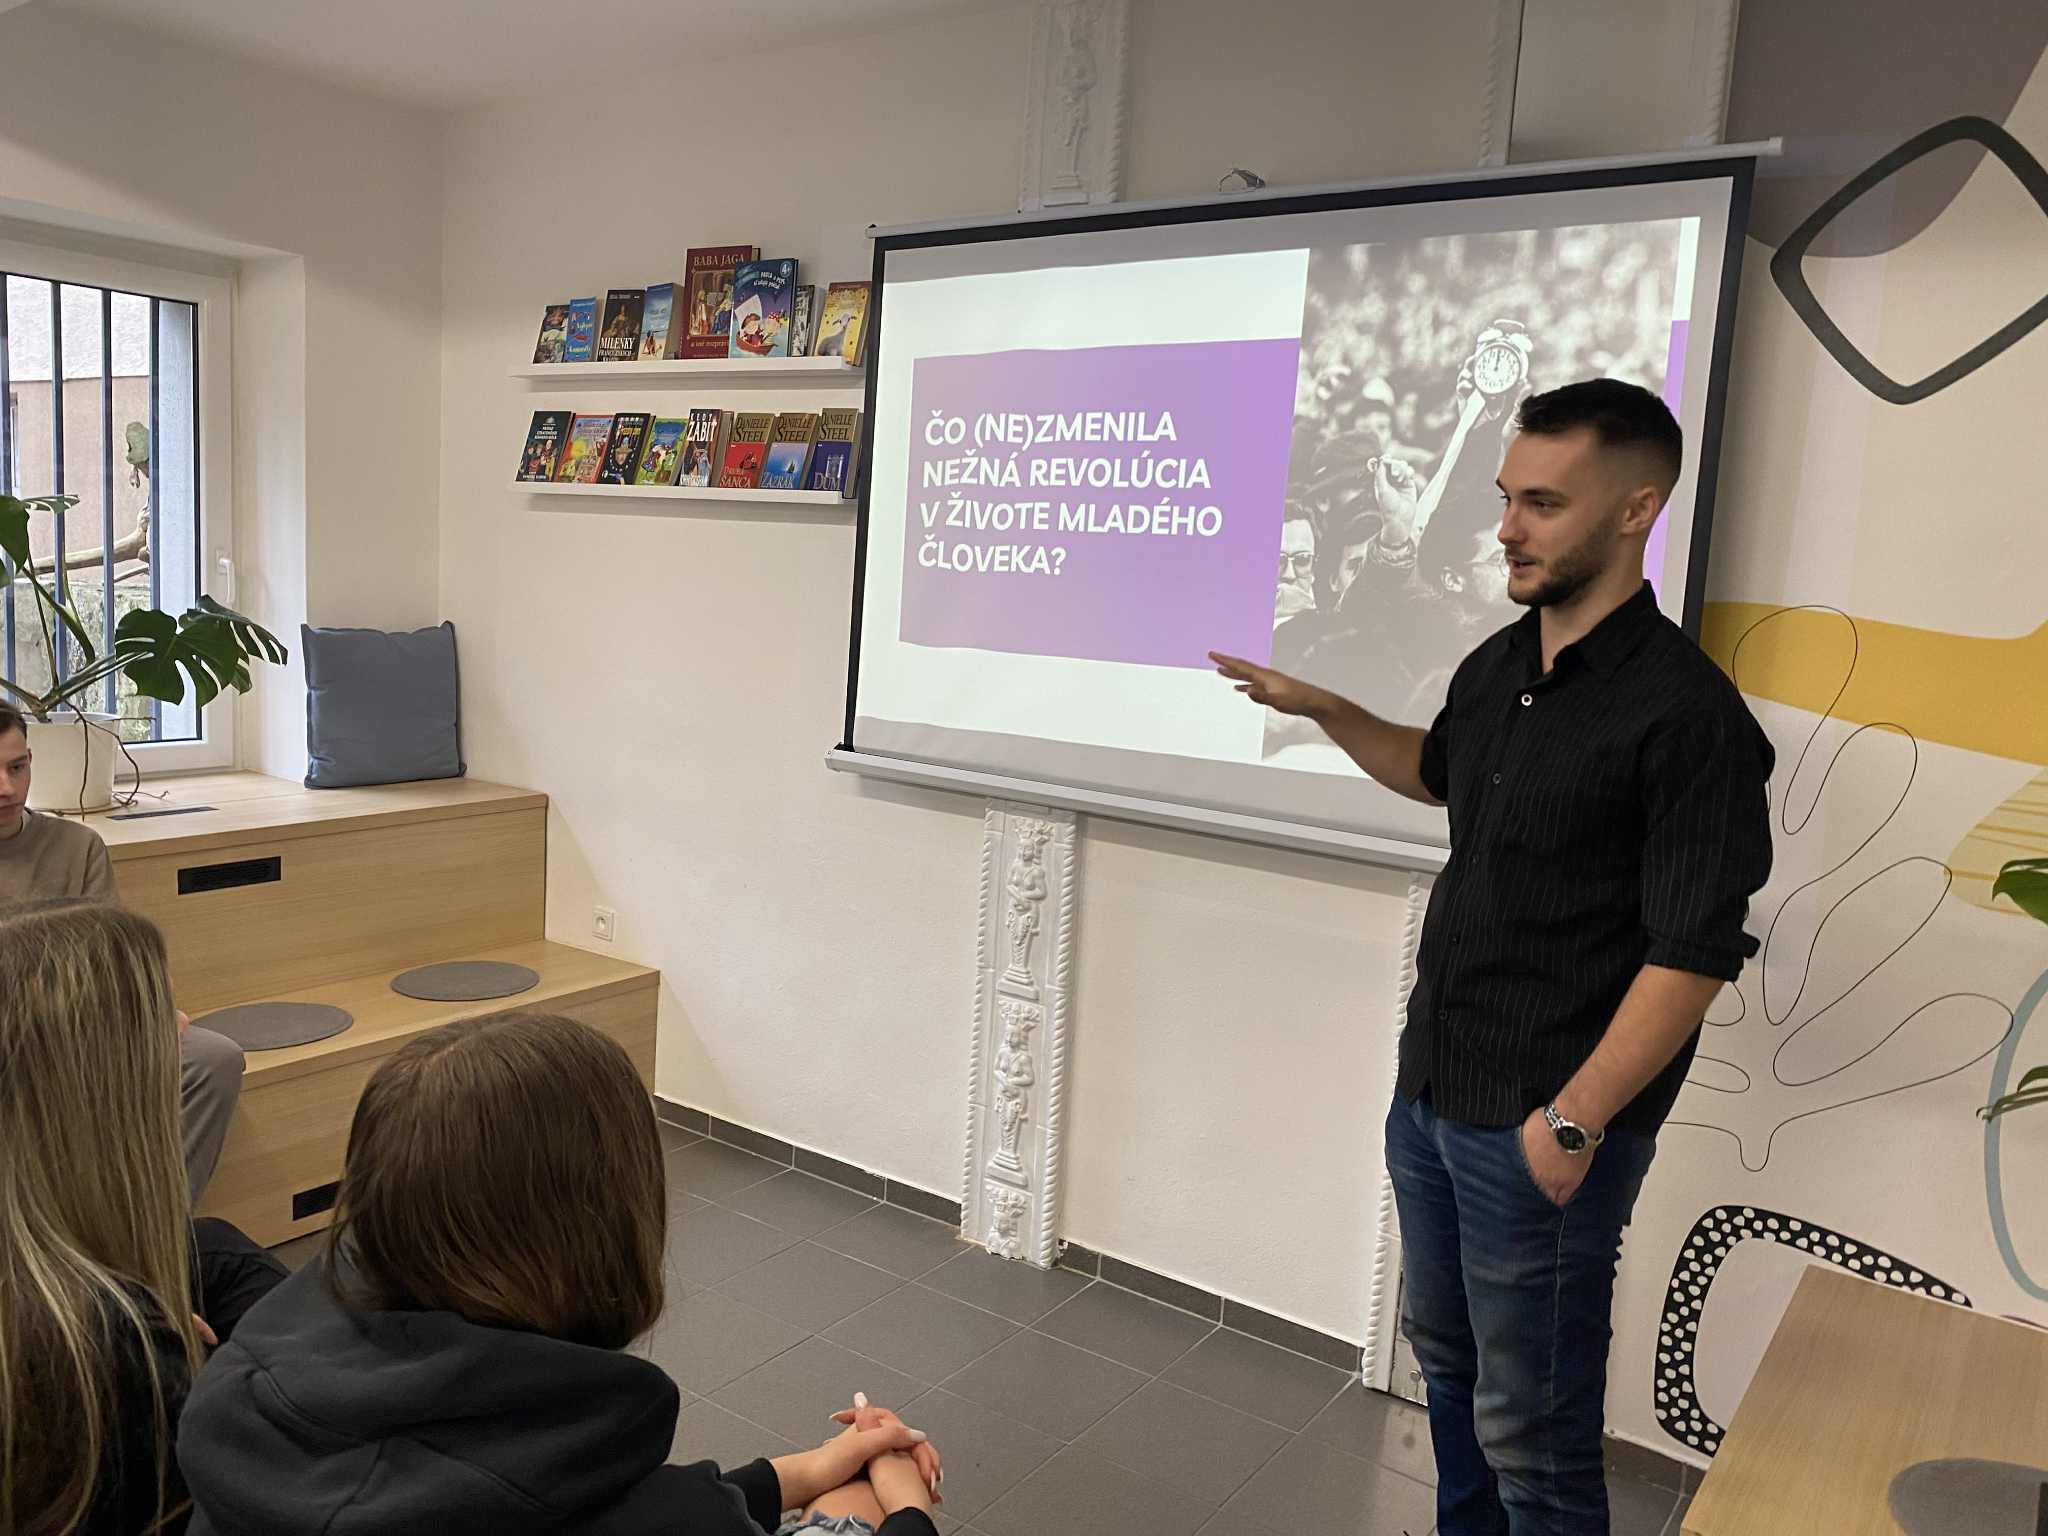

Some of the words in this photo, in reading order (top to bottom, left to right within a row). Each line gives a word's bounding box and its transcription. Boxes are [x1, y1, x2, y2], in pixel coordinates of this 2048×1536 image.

[694, 255, 718, 266] BABA
[721, 254, 744, 266] JAGA
[733, 428, 766, 442] STEEL
[775, 427, 808, 442] STEEL
[820, 425, 849, 441] STEEL
[925, 409, 966, 446] ČO
[974, 411, 1177, 451] (NE)ZMENILA
[922, 448, 1022, 488] NEŽNÁ
[1029, 450, 1211, 489] REVOLÚCIA
[920, 501, 941, 528] V
[945, 491, 1050, 531] ŽIVOTE
[1058, 497, 1223, 537] MLADÉHO
[918, 534, 1067, 576] ČLOVEKA?
